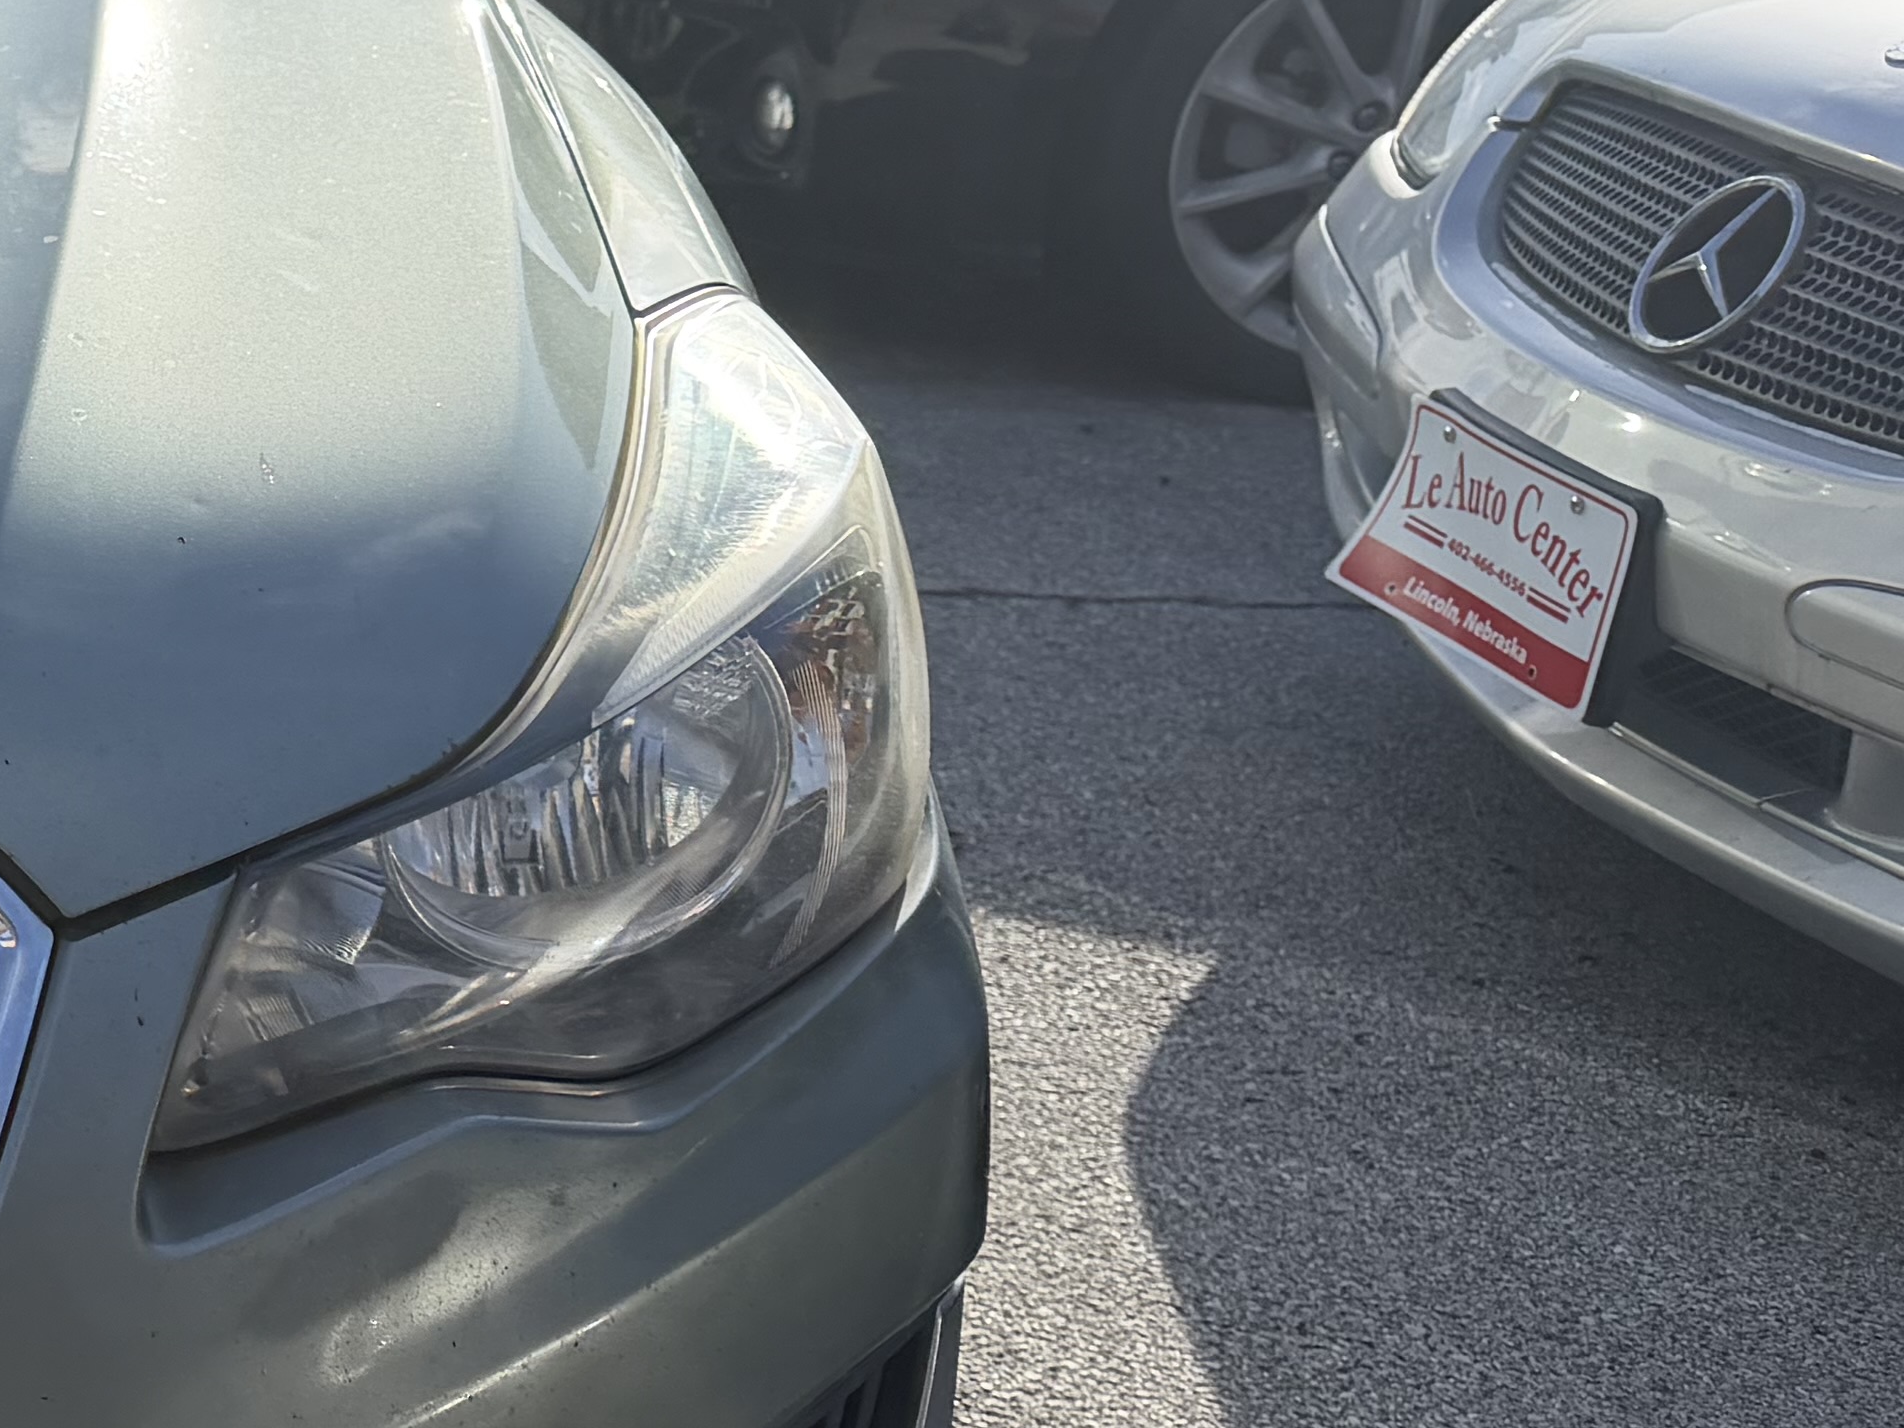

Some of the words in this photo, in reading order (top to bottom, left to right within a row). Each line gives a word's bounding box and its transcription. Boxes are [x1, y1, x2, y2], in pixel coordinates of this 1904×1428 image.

[1401, 453, 1443, 510] Le
[1444, 451, 1507, 526] Auto
[1513, 483, 1604, 619] Center
[1447, 538, 1526, 597] 402-466-4556
[1402, 576, 1462, 627] Lincoln,
[1462, 609, 1528, 665] Nebraska
